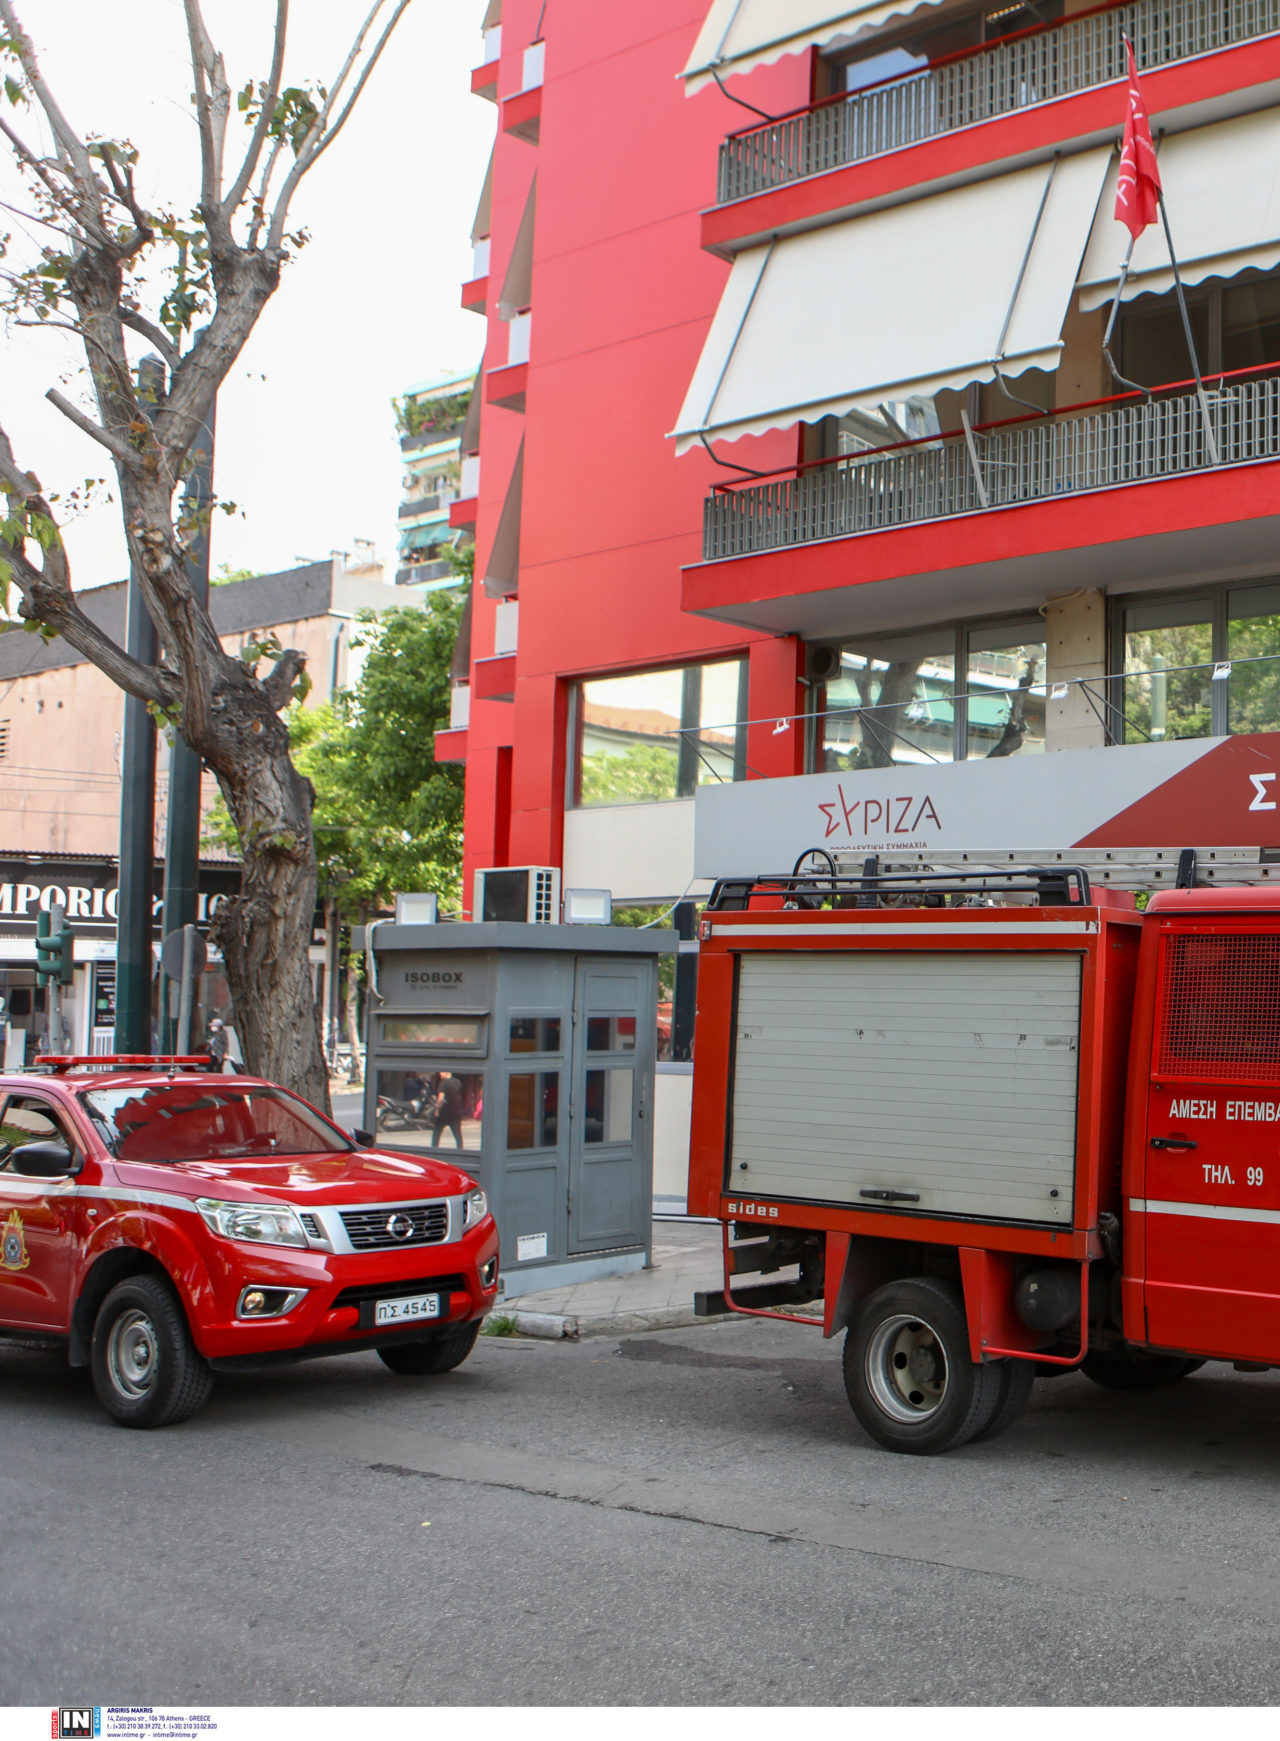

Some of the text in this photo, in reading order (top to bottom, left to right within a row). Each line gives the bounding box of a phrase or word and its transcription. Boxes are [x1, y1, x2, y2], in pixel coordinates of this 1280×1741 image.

[818, 783, 942, 838] ΣΥΡΙΖΑ
[405, 971, 464, 984] ISOBOX
[1169, 1099, 1217, 1120] ΑΜΕΣΗ
[1202, 1164, 1264, 1187] ΤΗΛ. 99
[728, 1201, 778, 1218] sides
